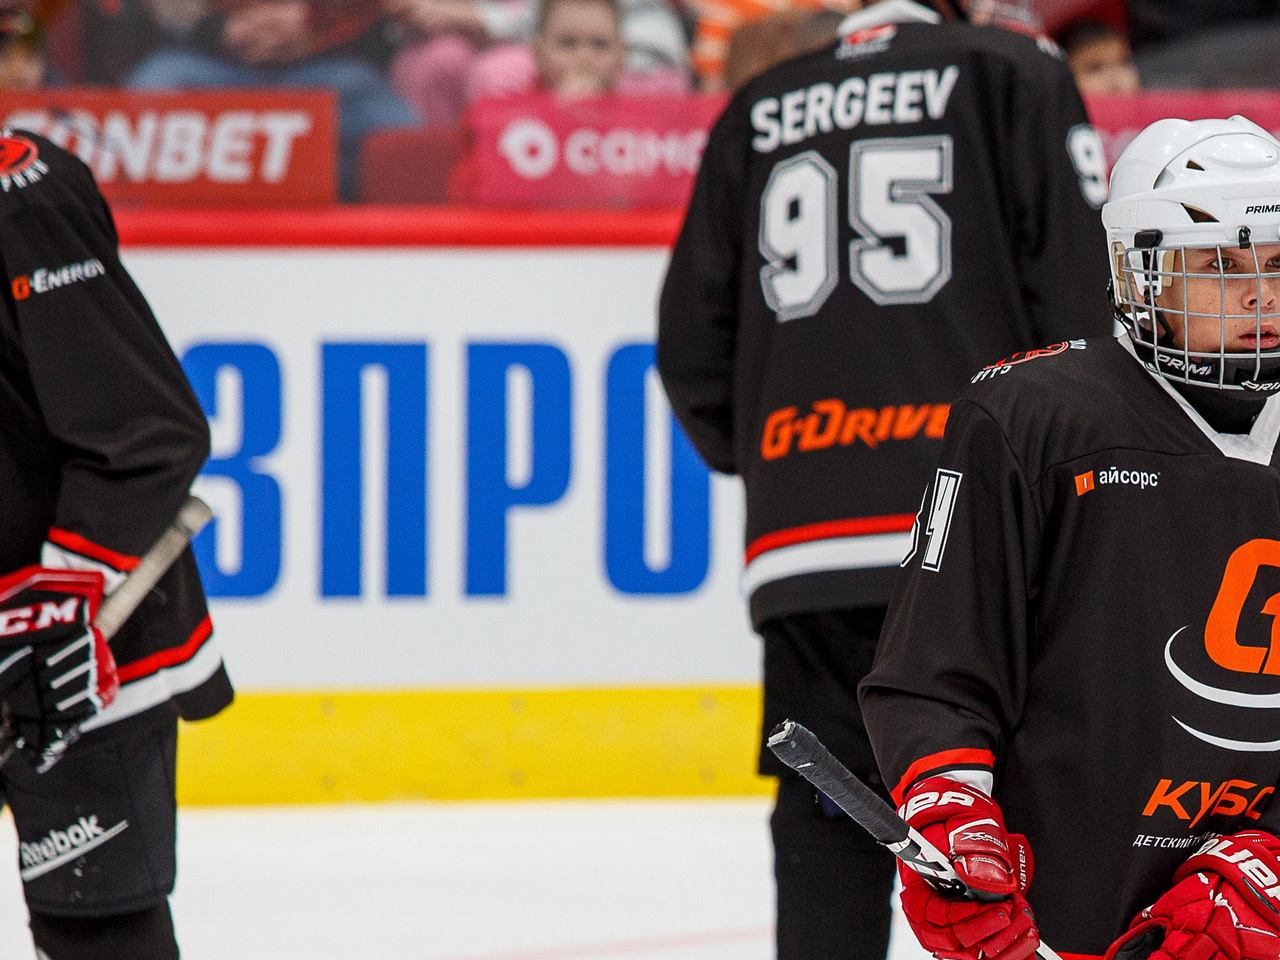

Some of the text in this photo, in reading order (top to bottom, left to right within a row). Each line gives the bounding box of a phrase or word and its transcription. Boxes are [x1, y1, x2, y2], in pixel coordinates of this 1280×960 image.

[751, 65, 960, 153] SERGEEV
[758, 135, 954, 323] 95
[1156, 353, 1213, 376] PRIM
[1099, 466, 1159, 489] айсорс
[1132, 833, 1192, 850] ДЕТСКИЙ
